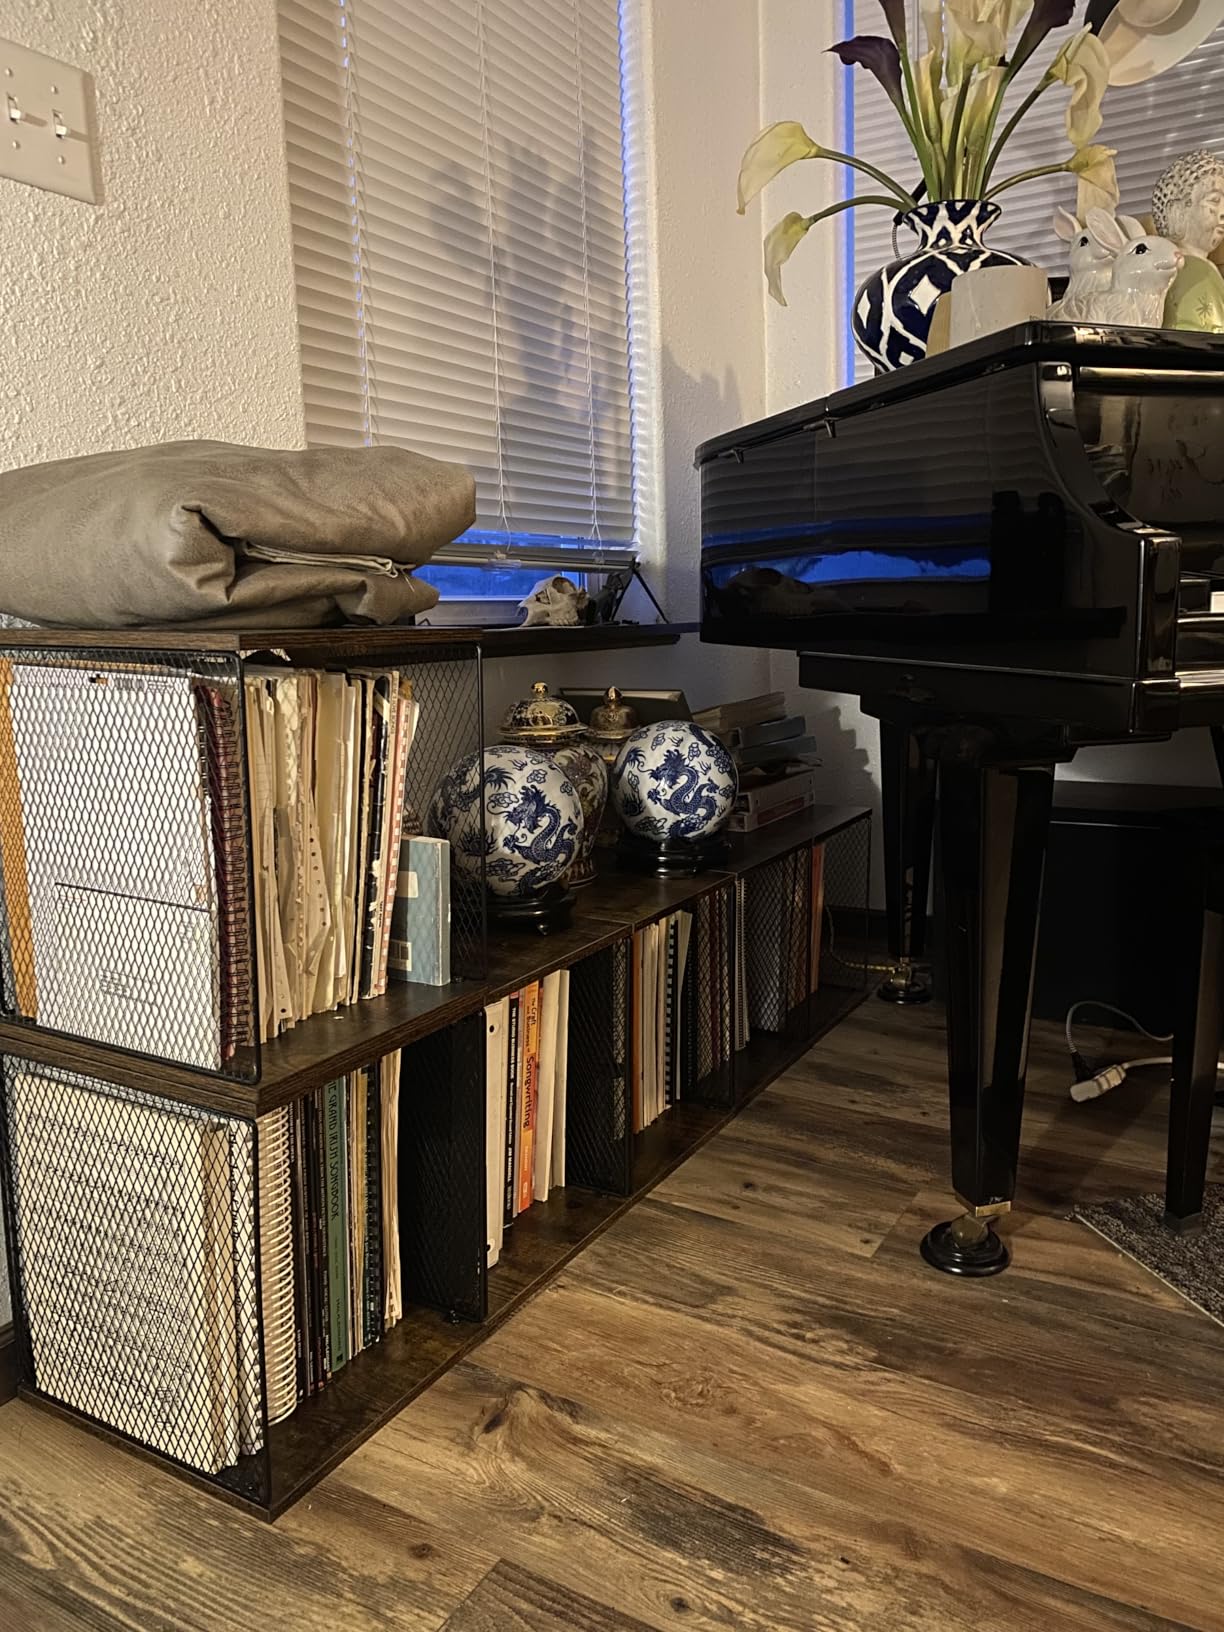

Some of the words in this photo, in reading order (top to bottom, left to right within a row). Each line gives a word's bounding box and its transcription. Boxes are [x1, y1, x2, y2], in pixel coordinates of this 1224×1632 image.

[328, 1096, 339, 1130] GRAND
[523, 1056, 534, 1128] Songwriting
[329, 1132, 339, 1160] IRISH
[330, 1162, 340, 1221] SONGBOOK
